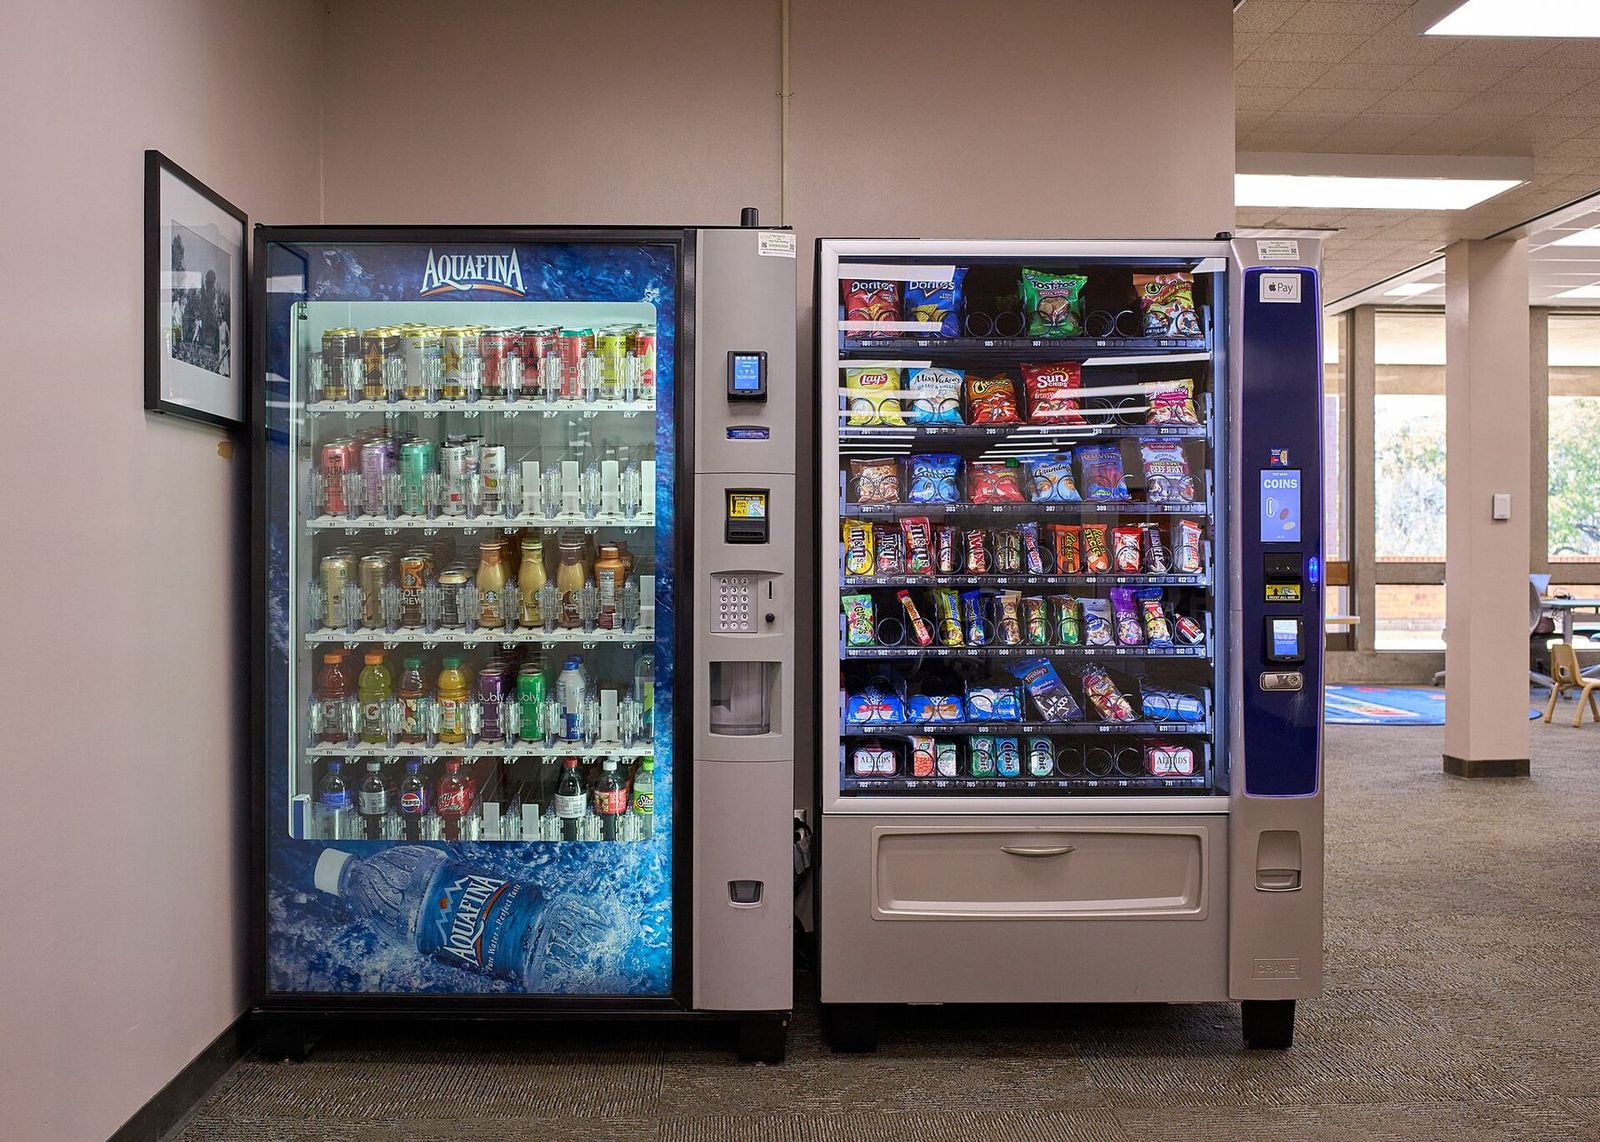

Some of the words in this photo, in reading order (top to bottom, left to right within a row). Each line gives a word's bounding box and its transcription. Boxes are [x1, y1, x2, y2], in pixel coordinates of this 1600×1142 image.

[421, 247, 523, 291] AQUAFINA
[852, 281, 895, 293] Doritos
[909, 280, 955, 291] Doritos
[1277, 282, 1293, 294] Pay
[915, 373, 934, 384] Miss
[1037, 374, 1065, 389] Sun
[1264, 480, 1297, 489] COINS
[967, 530, 986, 566] TWIX
[443, 875, 506, 966] AQUAFINA
[488, 931, 499, 955] Water
[496, 898, 513, 925] Perfect
[509, 882, 521, 901] Taste
